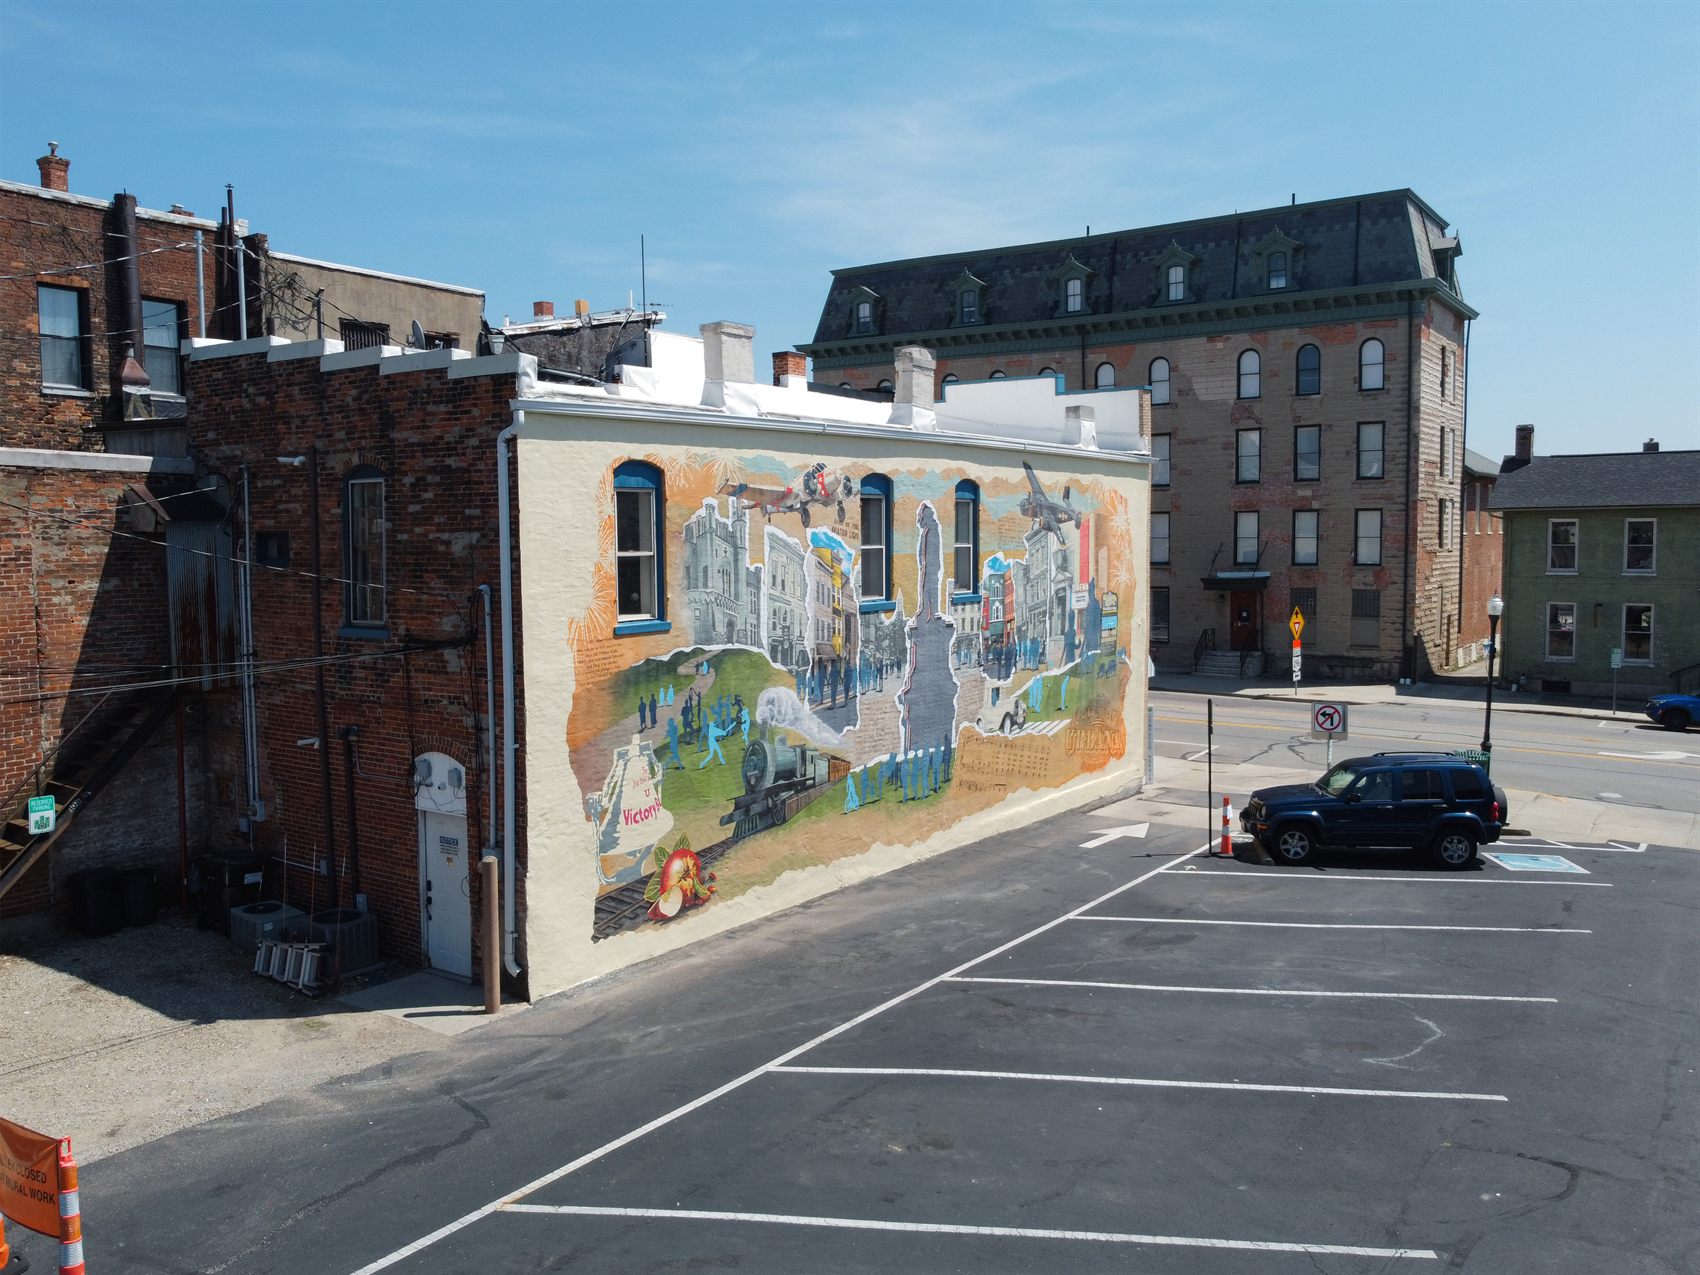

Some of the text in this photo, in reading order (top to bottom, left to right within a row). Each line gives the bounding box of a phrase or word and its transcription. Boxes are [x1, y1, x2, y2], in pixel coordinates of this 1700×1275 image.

[31, 798, 52, 806] RESERVED
[622, 803, 658, 826] Victory
[440, 837, 458, 846] NOTICE
[16, 1164, 47, 1184] CLOSED
[6, 1176, 28, 1196] MURAL
[29, 1186, 56, 1204] WORK
